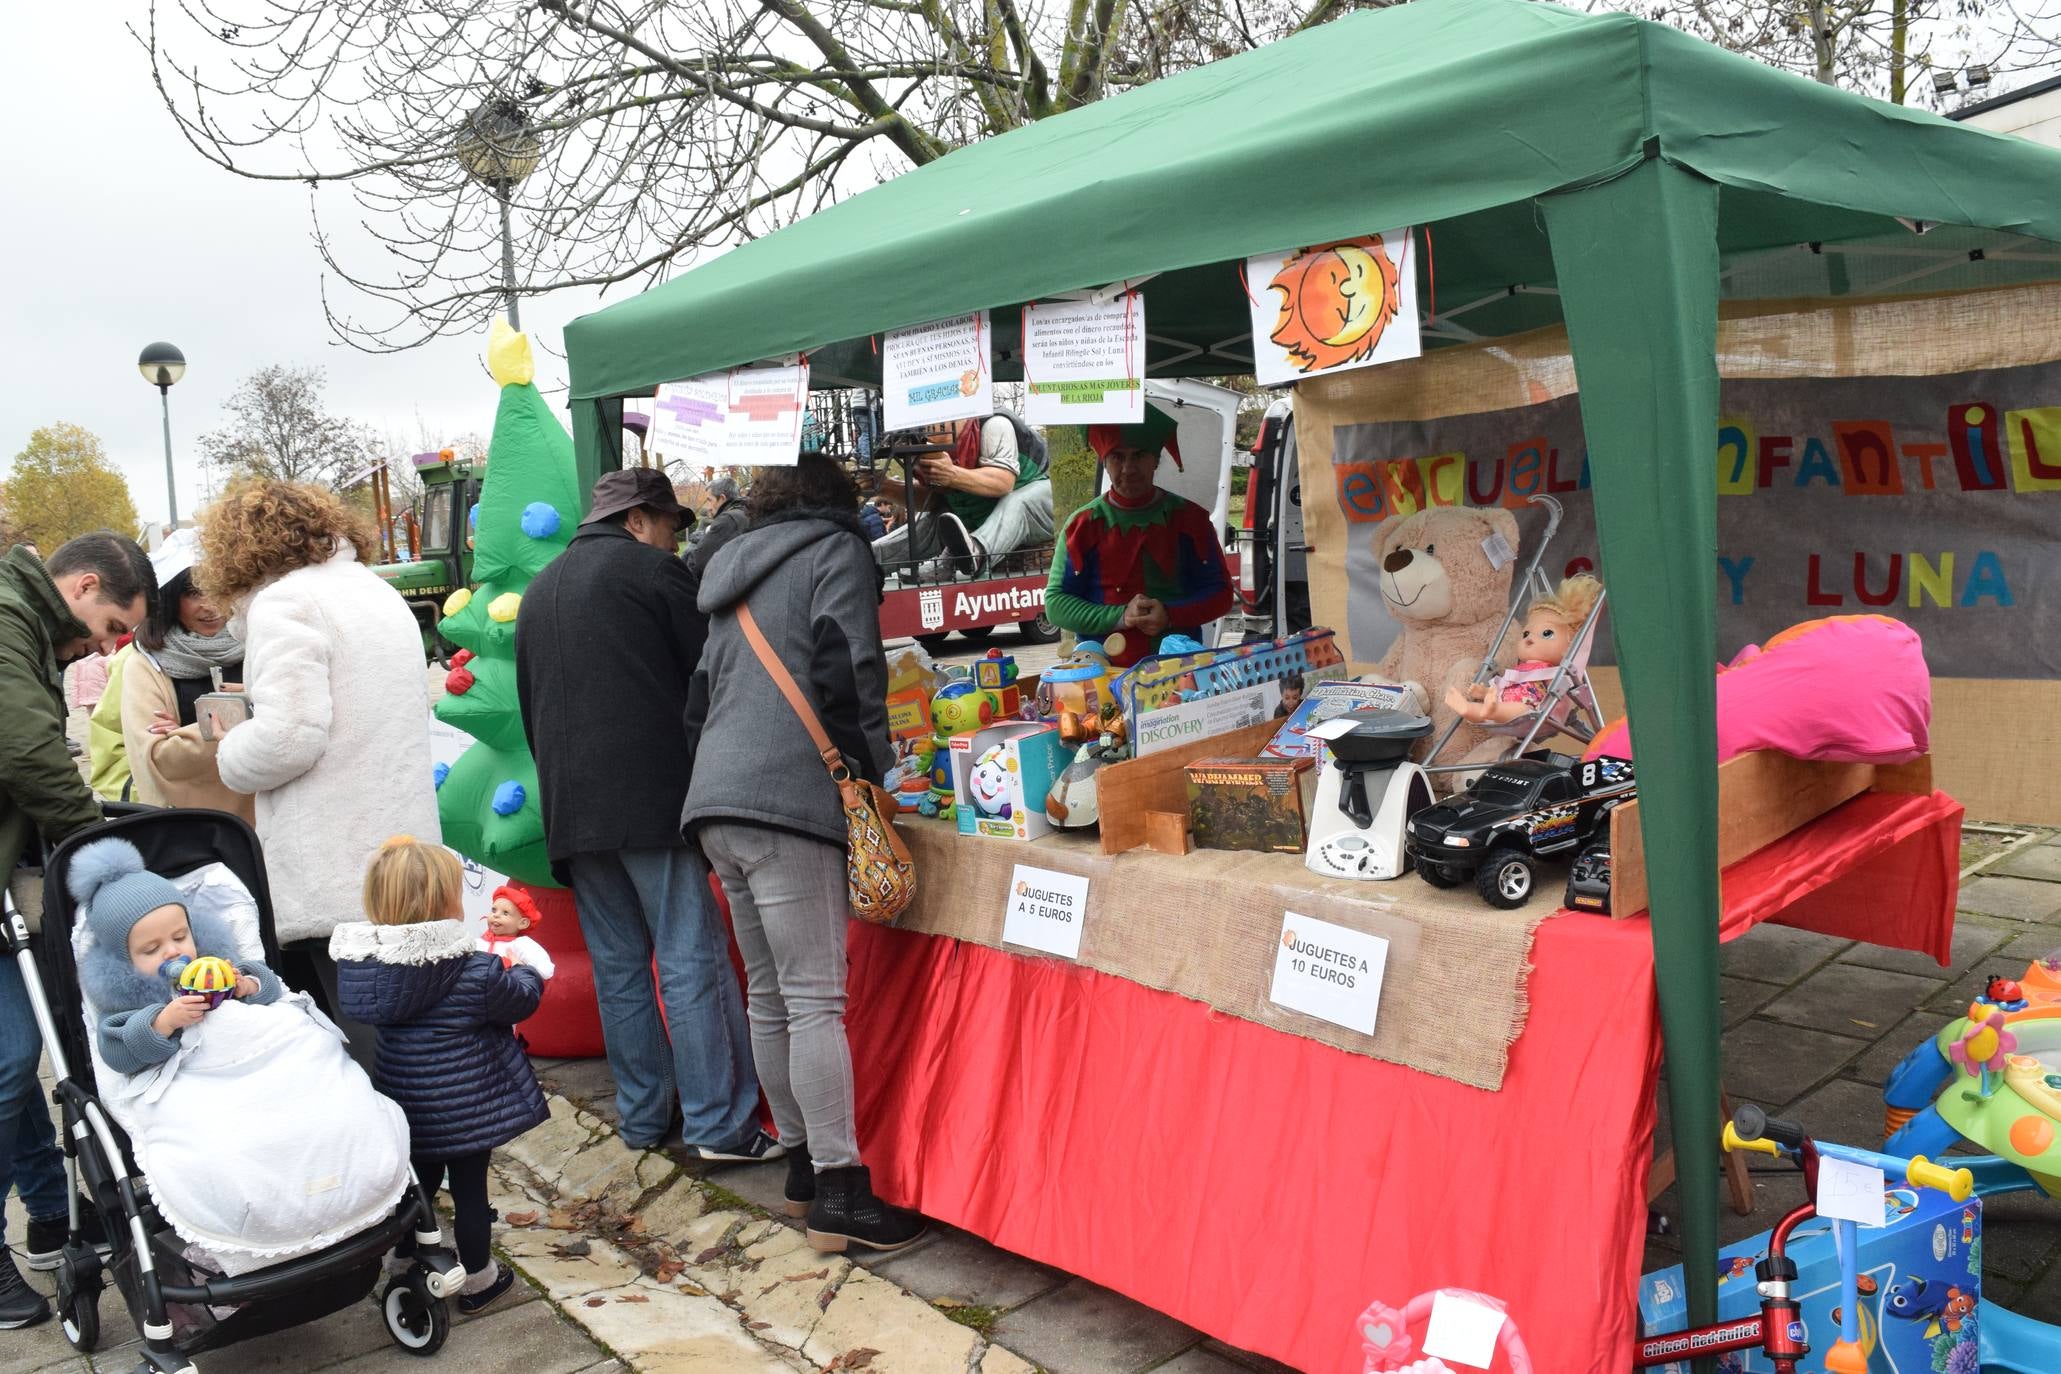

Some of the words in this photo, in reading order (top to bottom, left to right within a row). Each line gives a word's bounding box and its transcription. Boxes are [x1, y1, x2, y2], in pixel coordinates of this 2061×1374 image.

[941, 314, 976, 329] COLABOR
[1806, 551, 2016, 609] LUNA
[1140, 713, 1180, 730] imagination
[1140, 718, 1205, 745] DISCOVERY
[1190, 772, 1264, 786] WARHAMMER
[1582, 763, 1596, 786] 8
[1022, 887, 1073, 907] JUGUETES
[1018, 902, 1026, 913] A
[1029, 904, 1036, 915] 5
[1038, 905, 1073, 923] EUROS
[1288, 938, 1357, 970] JUGUETES
[1358, 959, 1368, 974] A
[1291, 958, 1306, 973] 10
[1310, 963, 1356, 989] EUROS
[1643, 1337, 1690, 1358] Chicco
